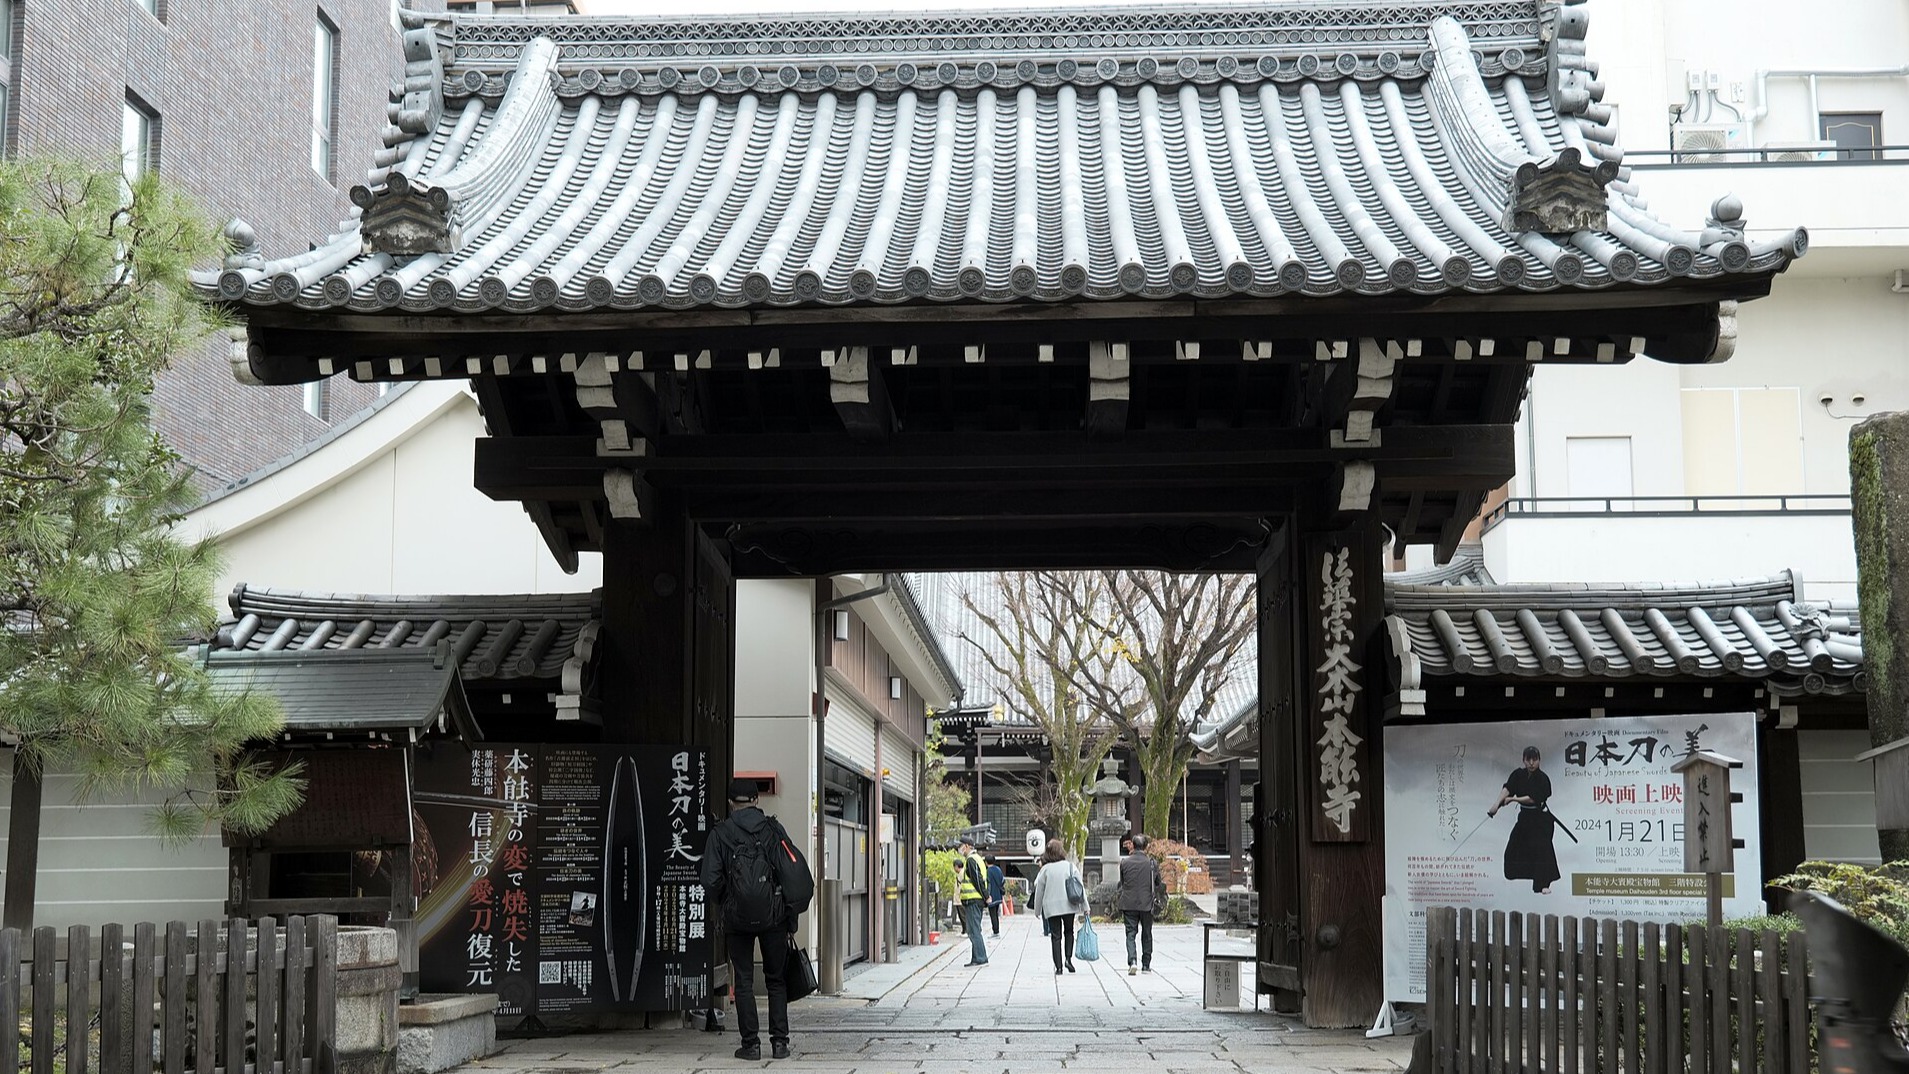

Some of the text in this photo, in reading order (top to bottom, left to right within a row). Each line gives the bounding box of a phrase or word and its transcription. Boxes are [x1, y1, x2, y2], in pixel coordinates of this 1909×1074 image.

[1564, 723, 1715, 767] 日本刀の美
[1564, 767, 1592, 778] Beauty
[1604, 766, 1640, 778] Japanese
[664, 751, 703, 861] 日本刀の美
[1574, 819, 1684, 842] 2024 1月21日
[1616, 808, 1656, 816] Screening
[1698, 774, 1710, 864] 進入禁止
[502, 748, 529, 972] 本能寺の変で焼失した
[1620, 847, 1644, 857] 13:30
[466, 811, 494, 987] 信長の愛刀復元
[689, 884, 705, 938] 特別展
